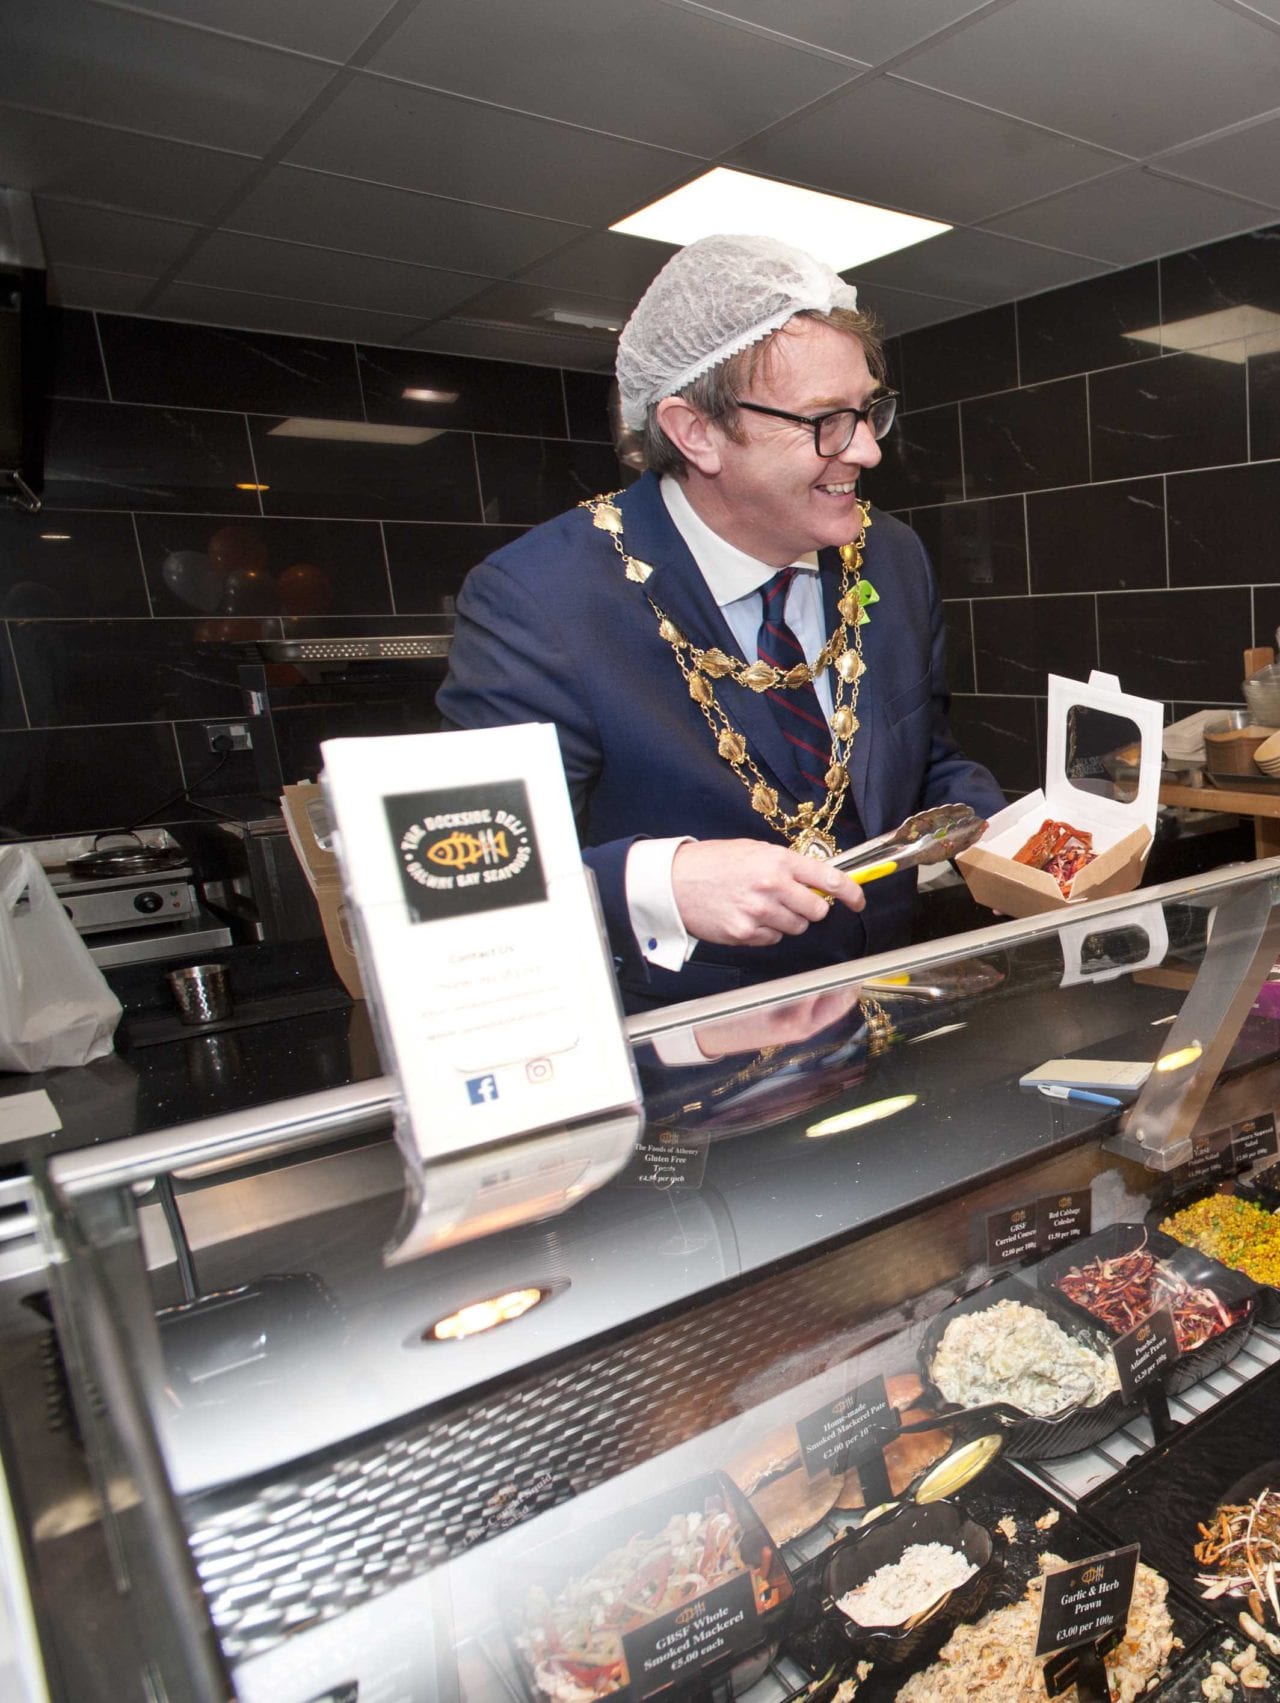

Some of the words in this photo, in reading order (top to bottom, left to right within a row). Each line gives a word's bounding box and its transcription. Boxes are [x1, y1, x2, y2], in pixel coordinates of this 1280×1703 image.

[494, 810, 527, 836] DELI
[635, 1143, 647, 1151] The
[647, 1144, 666, 1152] Foods
[644, 1153, 669, 1162] Gluten
[670, 1155, 687, 1163] Free
[1048, 1211, 1060, 1219] Red
[995, 1233, 1017, 1246] Curried
[1060, 1231, 1069, 1239] per
[1015, 1245, 1025, 1254] per
[823, 1403, 867, 1432] Home-made
[806, 1431, 836, 1454] Smoked
[836, 1410, 870, 1436] Mackerel
[844, 1434, 859, 1448] per
[1060, 1589, 1088, 1606] Garlic
[1088, 1585, 1097, 1596] &
[1098, 1578, 1120, 1594] Herb
[1074, 1599, 1102, 1615] Prawn
[655, 1624, 691, 1650] GBSF
[692, 1607, 729, 1630] Whole
[1056, 1624, 1078, 1641] €3.00
[1078, 1621, 1094, 1635] per
[1095, 1614, 1114, 1628] 100g
[643, 1639, 691, 1672] Smoked
[692, 1609, 745, 1645] Mackerel
[670, 1649, 699, 1671] €5.00
[700, 1637, 725, 1656] each
